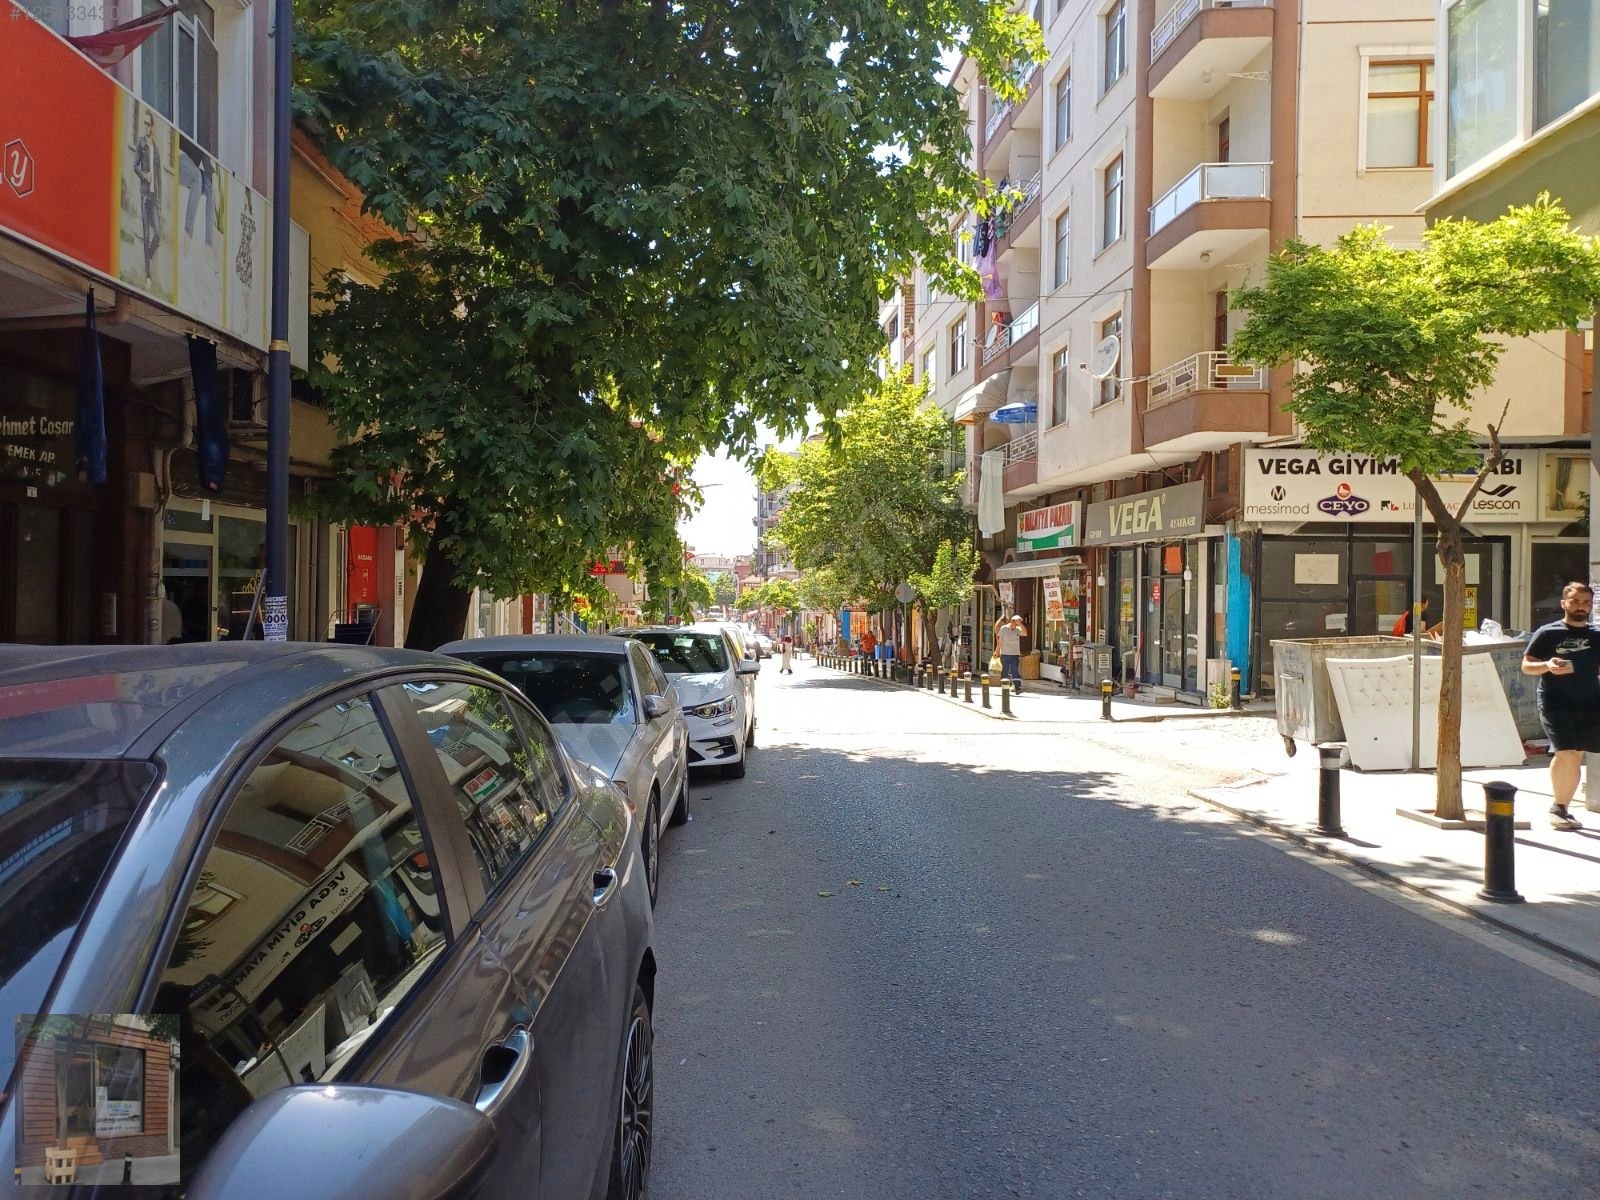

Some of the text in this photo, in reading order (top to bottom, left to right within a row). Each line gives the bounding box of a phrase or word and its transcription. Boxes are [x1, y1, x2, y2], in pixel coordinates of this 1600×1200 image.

[8, 445, 36, 460] EMEK
[1258, 459, 1321, 475] VEGA
[1328, 454, 1397, 475] GİYİM
[1247, 503, 1310, 515] messimod
[1320, 500, 1367, 511] CEYO
[1109, 496, 1162, 536] VEGA
